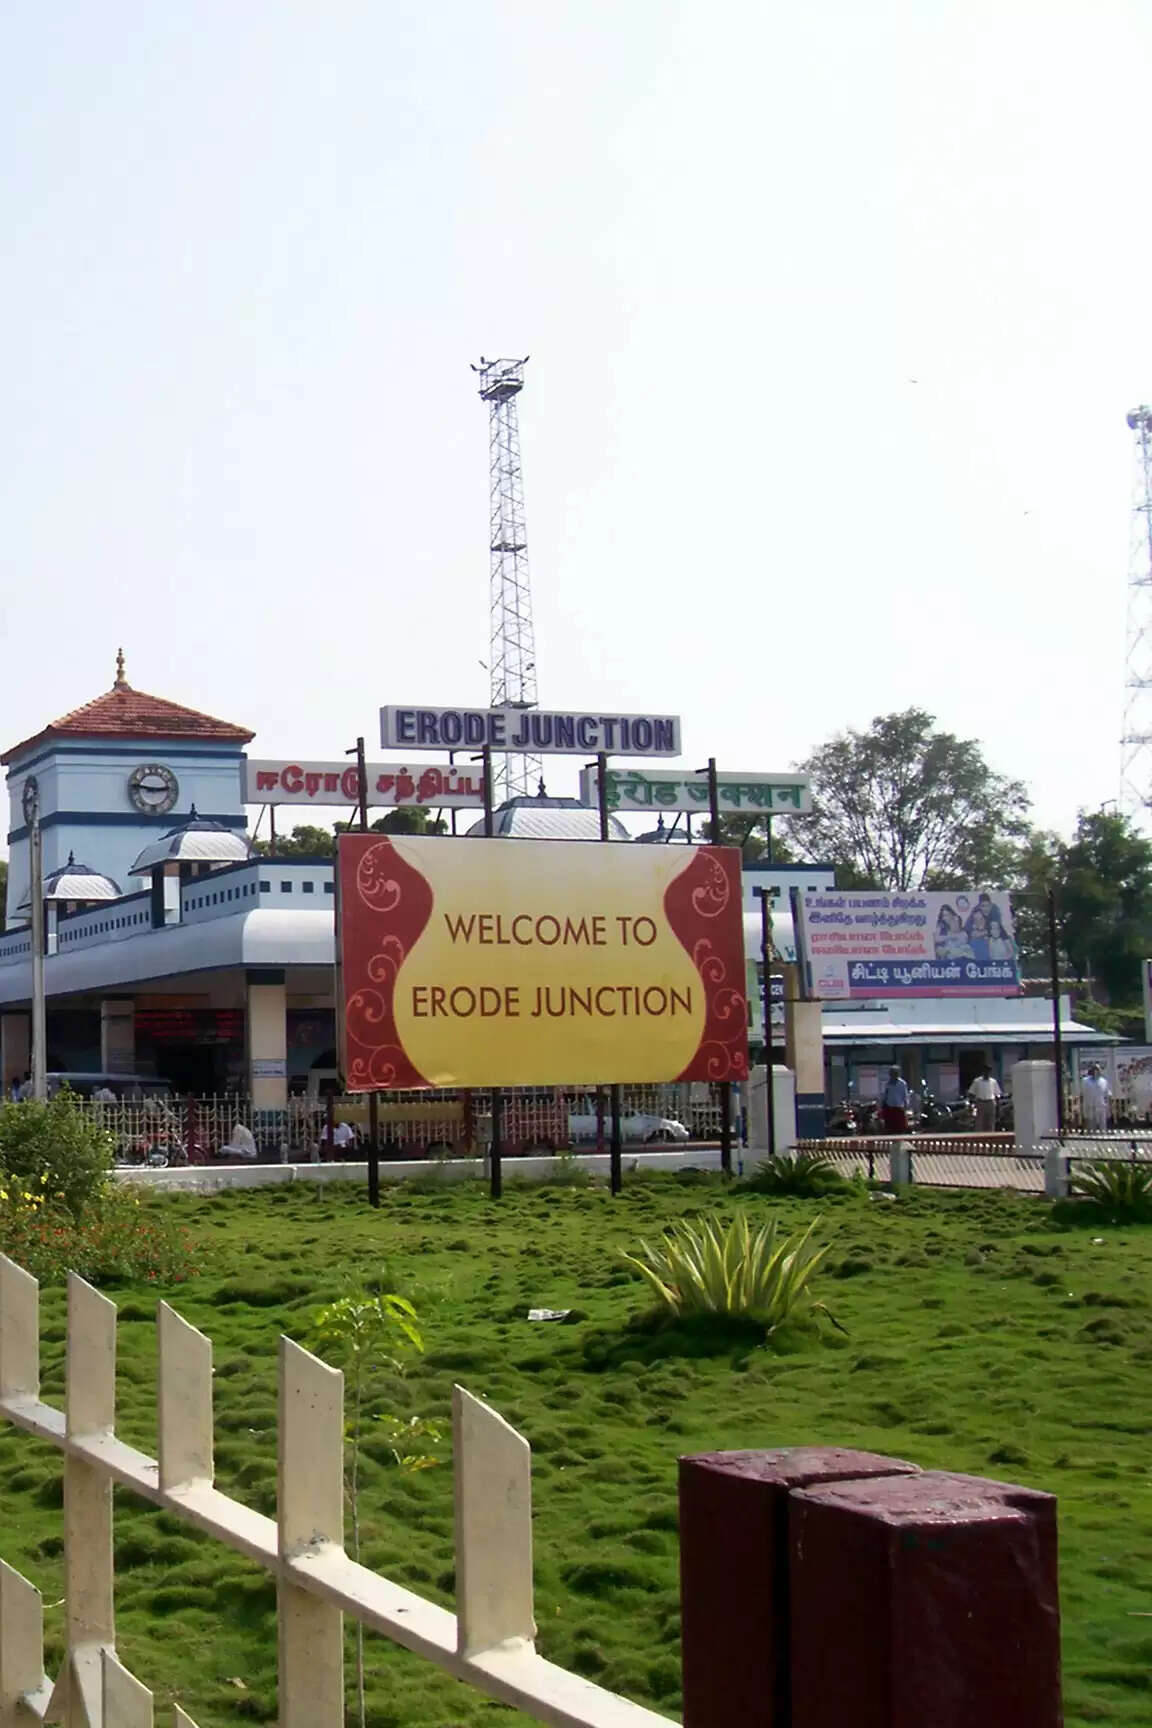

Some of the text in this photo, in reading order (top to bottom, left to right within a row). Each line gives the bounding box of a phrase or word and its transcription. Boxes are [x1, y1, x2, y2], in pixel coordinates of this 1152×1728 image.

[396, 709, 675, 751] ERODE JUNCTION
[444, 913, 657, 946] WELCOME TO
[851, 961, 1014, 984] சிட்டி யூனியன் பேங்க்
[413, 986, 693, 1017] ERODE JUNCTION
